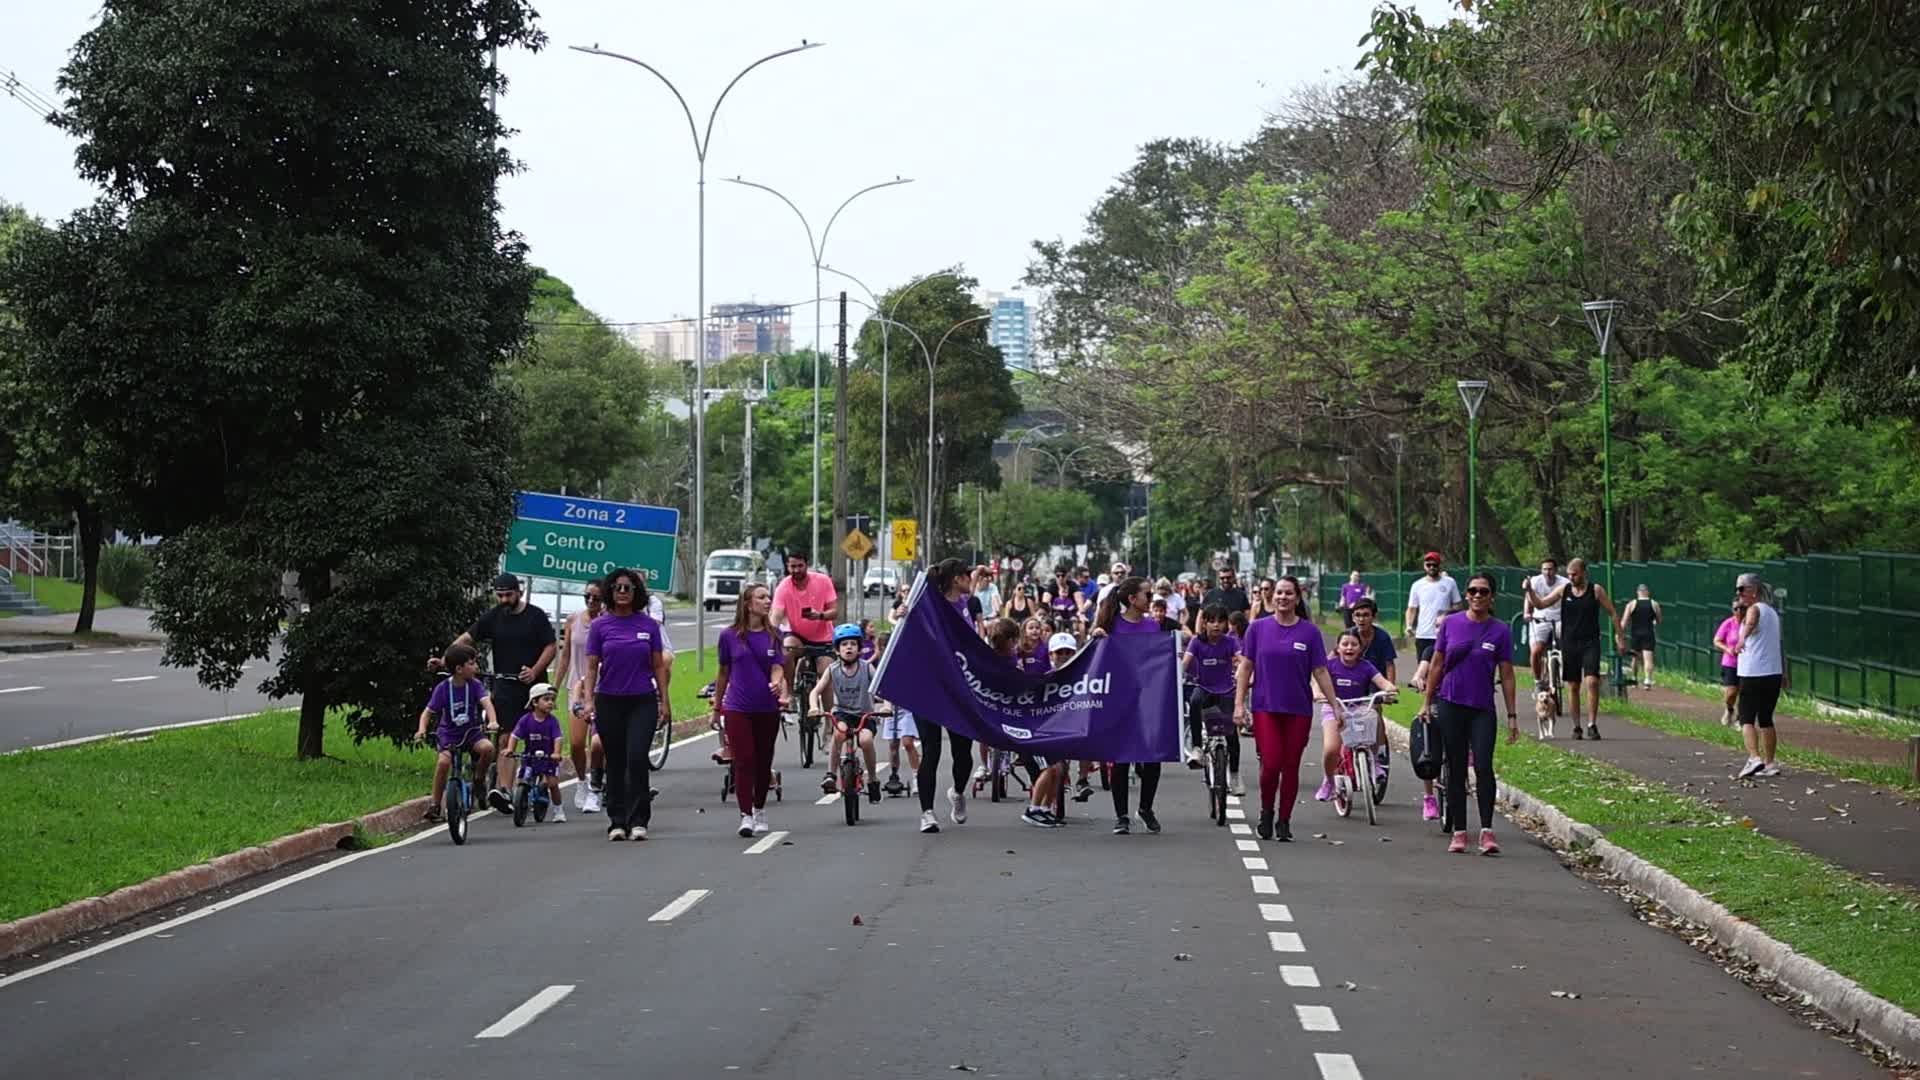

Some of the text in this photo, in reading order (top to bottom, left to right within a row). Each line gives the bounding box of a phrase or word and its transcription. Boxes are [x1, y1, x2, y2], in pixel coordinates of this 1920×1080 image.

[564, 504, 626, 524] Zona 2
[544, 532, 605, 552] Centro
[543, 554, 598, 575] Duque
[1016, 691, 1035, 705] &
[1043, 672, 1112, 703] Pedal
[1002, 700, 1104, 718] QUE TRANSFORMAM
